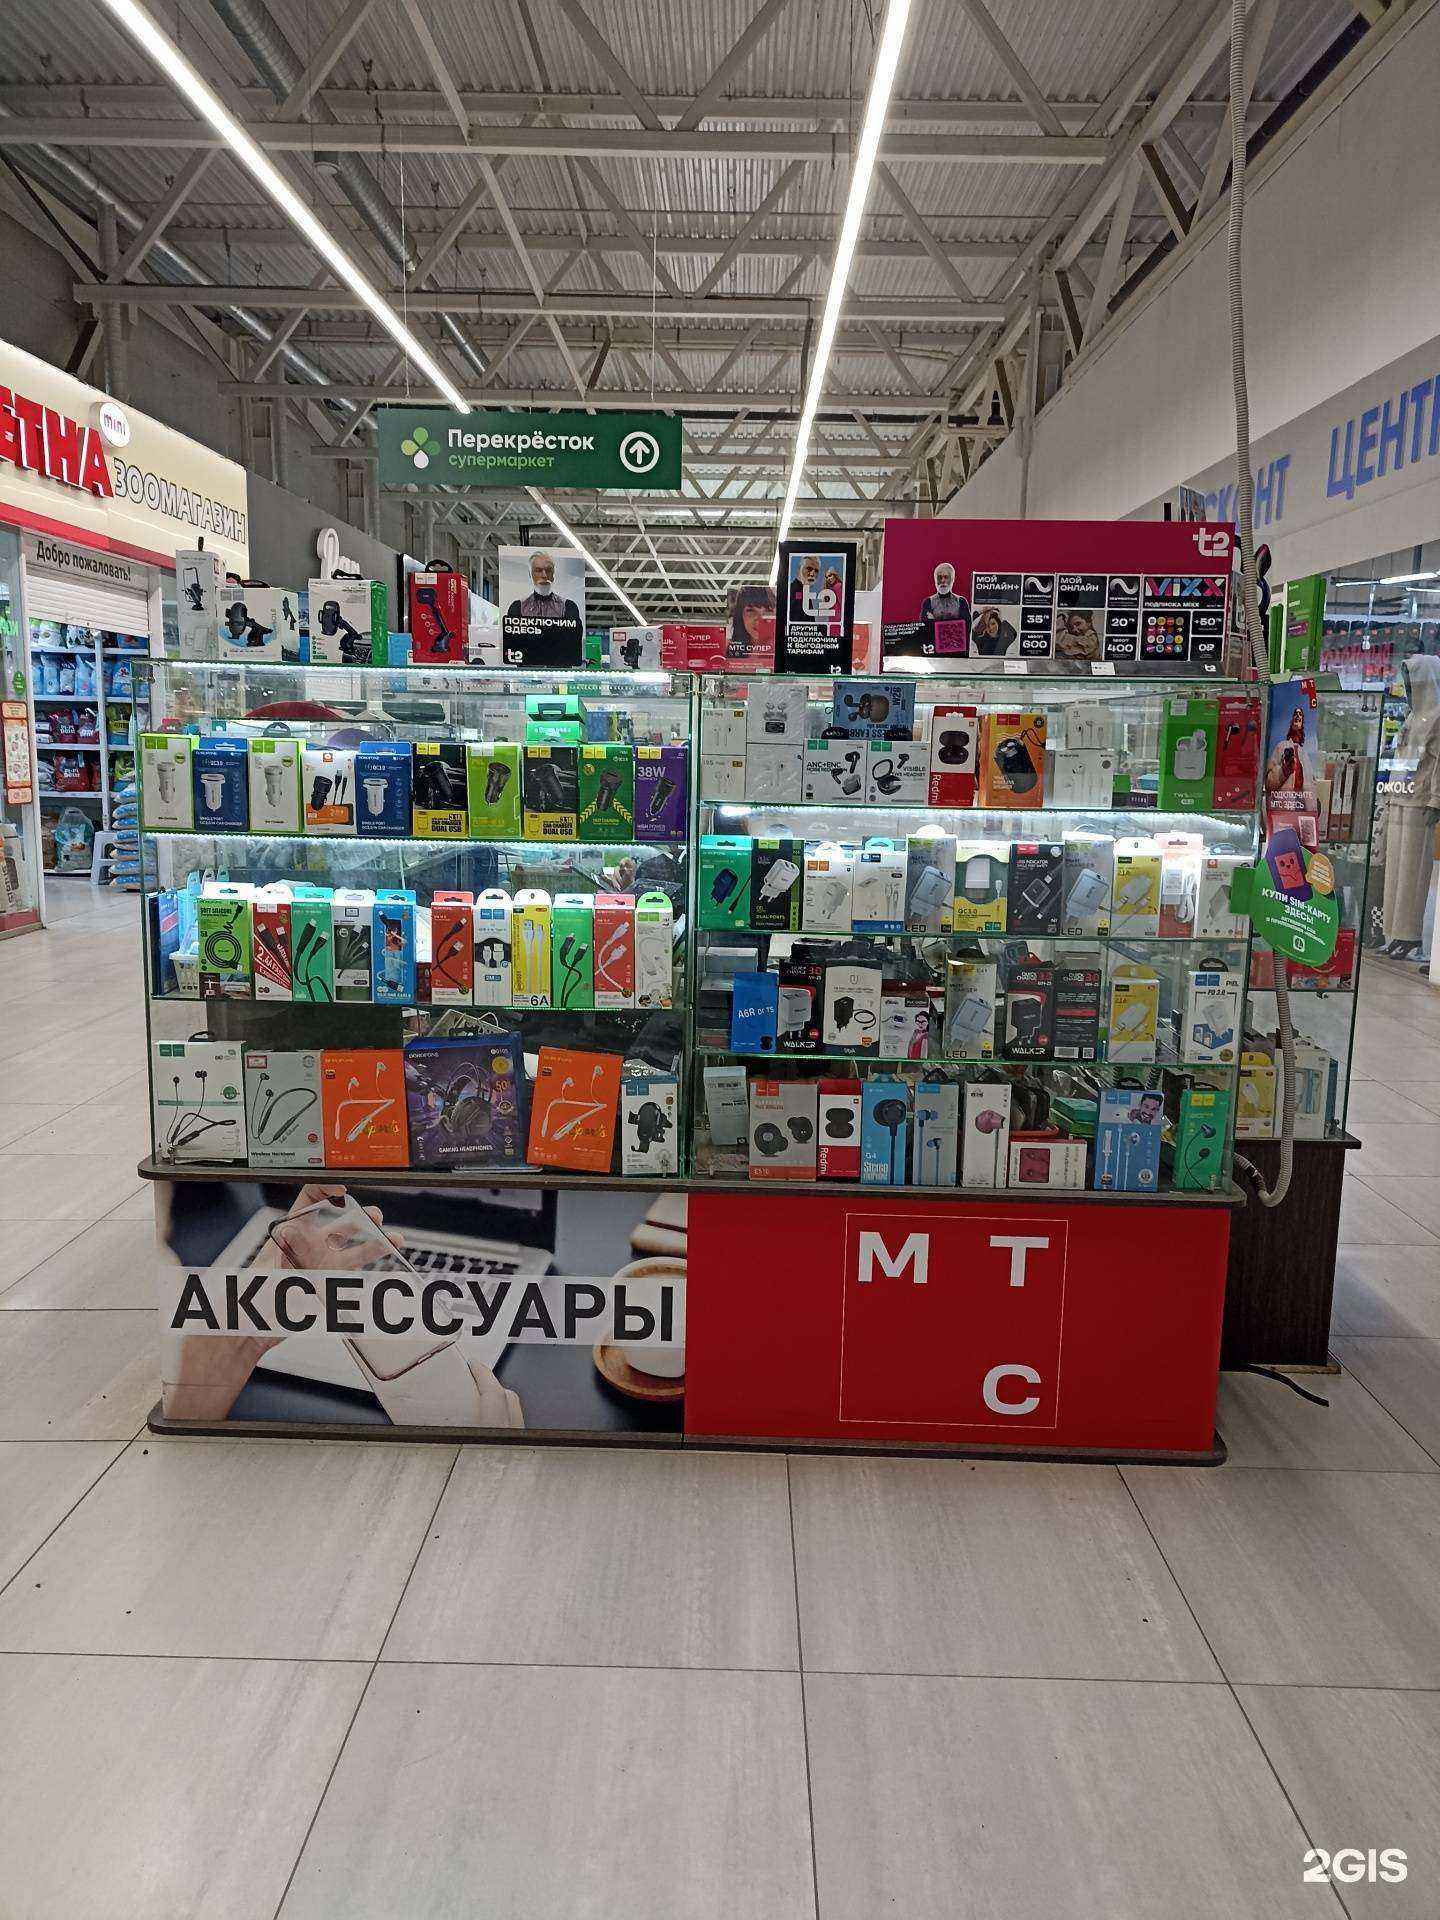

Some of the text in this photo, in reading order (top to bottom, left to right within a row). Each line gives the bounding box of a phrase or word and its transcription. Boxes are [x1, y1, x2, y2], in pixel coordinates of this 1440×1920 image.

[103, 412, 127, 437] mini
[449, 428, 594, 452] Перекрёсток
[449, 454, 555, 469] супермаркет
[113, 457, 246, 545] ЗООМАГАЗИН
[1193, 527, 1230, 557] t2
[36, 540, 132, 583] Добро пожаловать!
[1060, 584, 1099, 592] ОНЛАЙН
[504, 617, 576, 628] ПОДКЛЮЧИМ
[504, 626, 542, 635] ЗДЕСЬ
[1111, 618, 1128, 626] 20
[1107, 643, 1134, 652] 400
[638, 767, 666, 777] 38W
[932, 774, 942, 804] Redmi
[1262, 888, 1331, 924] КУПИ SIM-КАРТУ
[531, 996, 549, 1006] 6A
[819, 1147, 829, 1176] Redmi
[170, 1273, 674, 1342] АКСЕССУАРЫ
